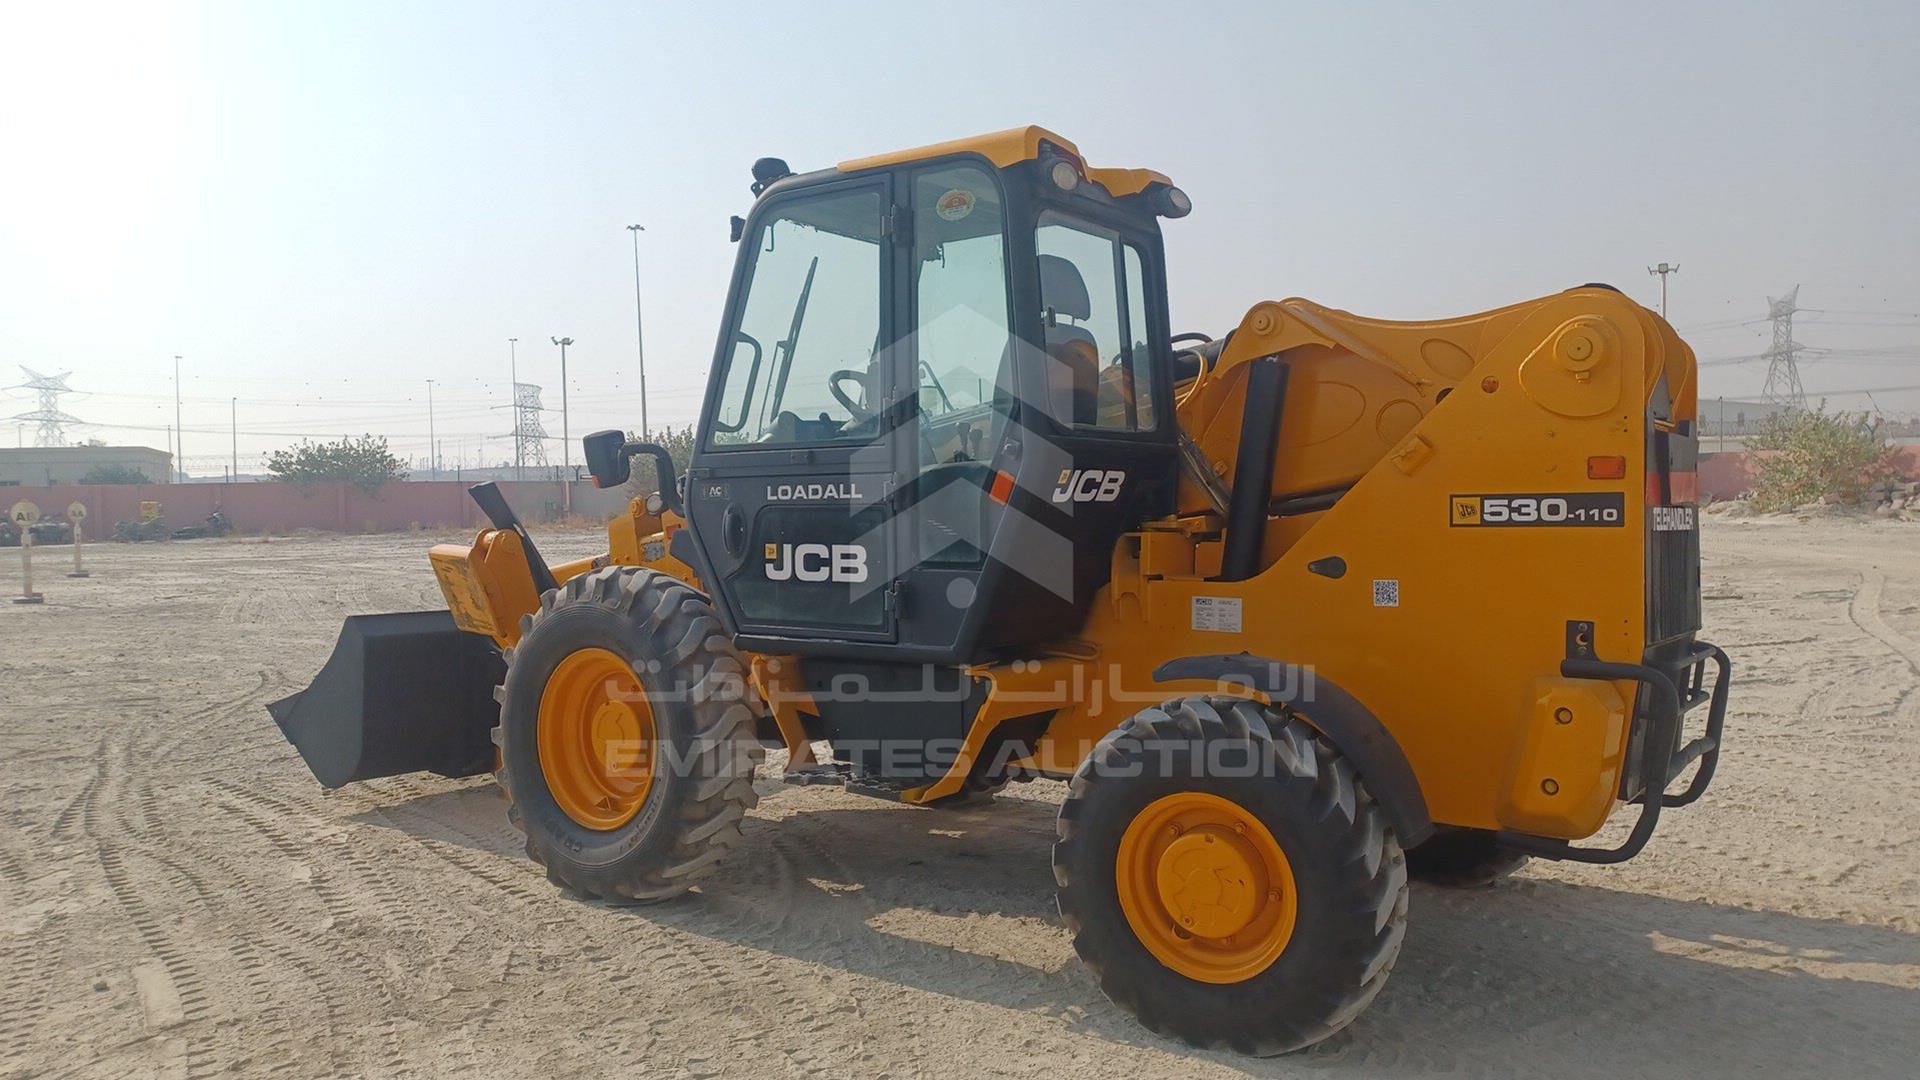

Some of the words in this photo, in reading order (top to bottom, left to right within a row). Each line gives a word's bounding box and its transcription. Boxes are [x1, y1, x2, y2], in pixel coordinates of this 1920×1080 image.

[766, 483, 863, 501] LOADALL
[1052, 469, 1126, 503] JCB
[1483, 498, 1618, 522] 530-110
[1653, 507, 1693, 531] TELEHANDLER
[765, 543, 868, 583] JCB
